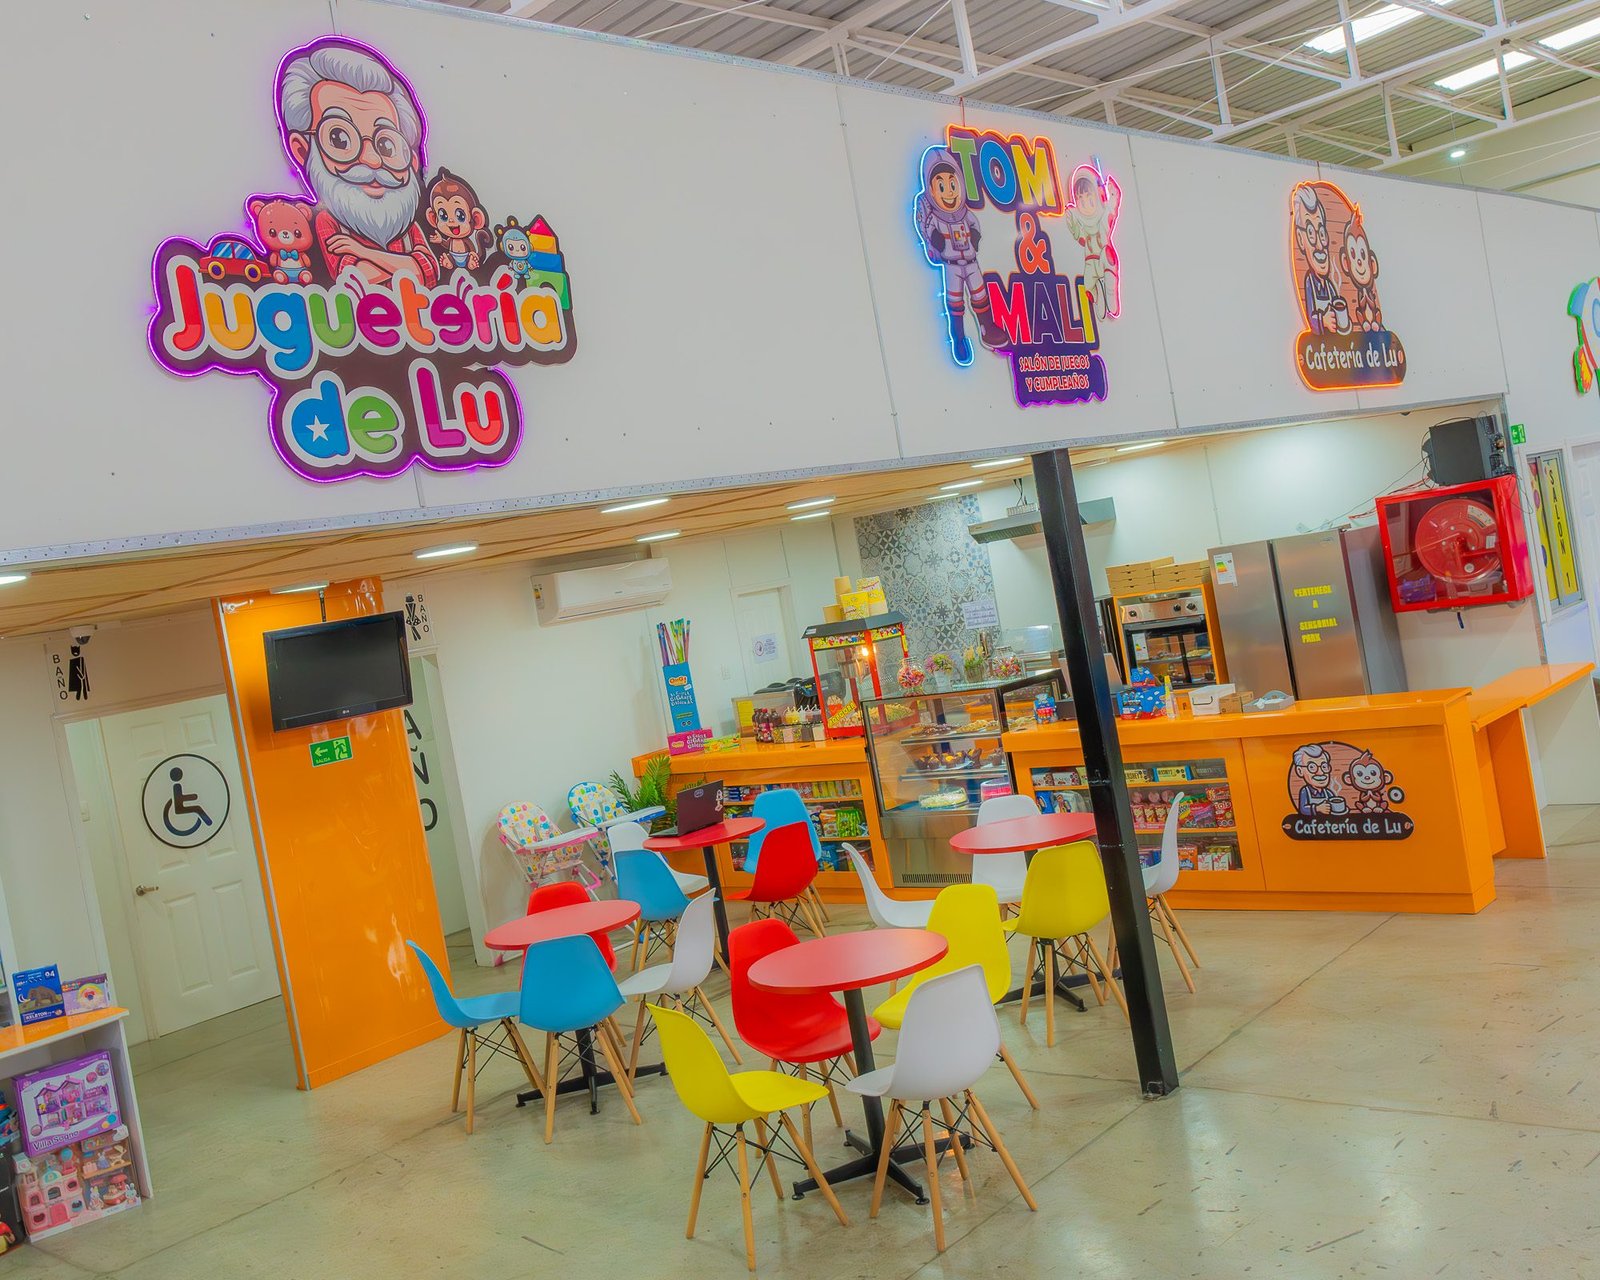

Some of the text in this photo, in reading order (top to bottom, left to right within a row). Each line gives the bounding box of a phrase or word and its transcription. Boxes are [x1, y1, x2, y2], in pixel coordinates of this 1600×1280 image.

[950, 136, 1057, 207] TOM
[1019, 212, 1050, 275] &
[172, 264, 563, 371] Juguetería
[986, 281, 1096, 345] MALI
[1019, 353, 1090, 372] SALÓN DE JUEGOS
[1025, 373, 1089, 392] Y CUMPLEAÑOS
[1305, 342, 1398, 371] Cafetería de Lu
[290, 367, 500, 459] de Lu
[52, 654, 68, 700] BAÑO
[403, 709, 438, 831] AÑO
[1294, 817, 1402, 836] Cafetería de Lu
